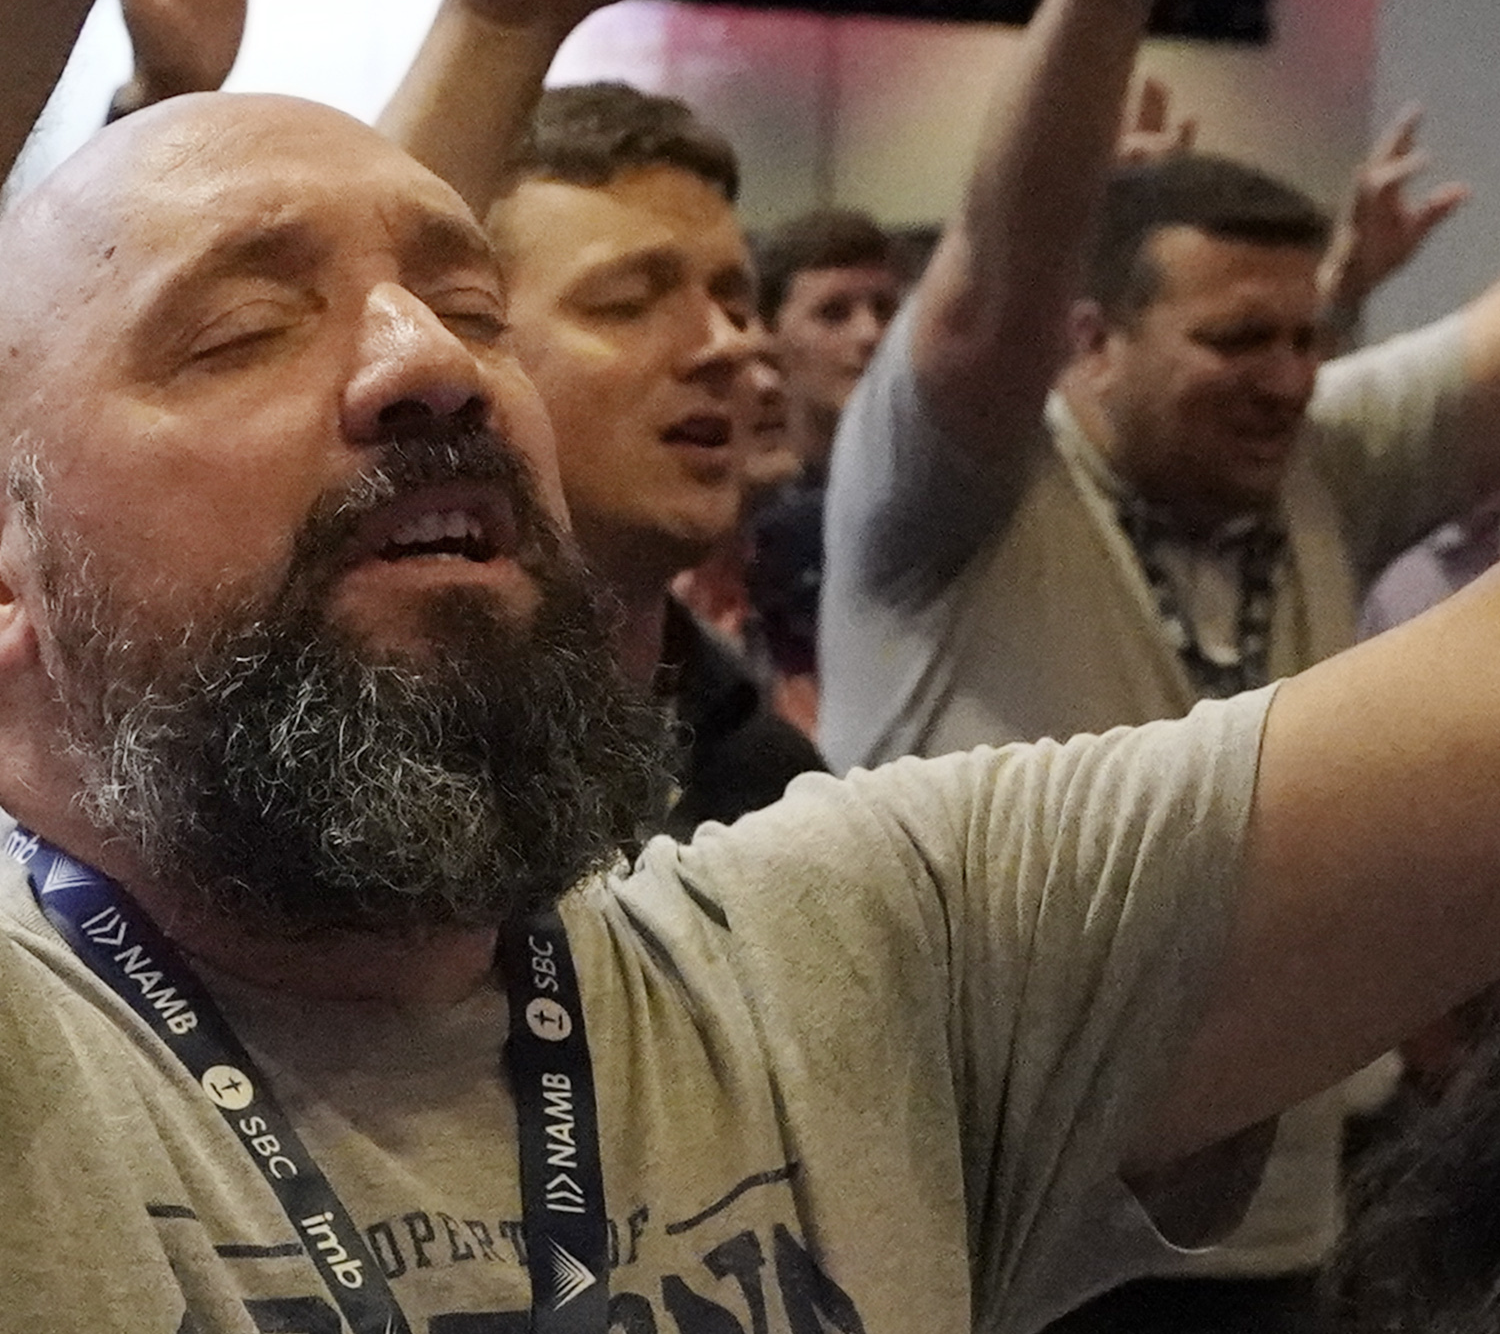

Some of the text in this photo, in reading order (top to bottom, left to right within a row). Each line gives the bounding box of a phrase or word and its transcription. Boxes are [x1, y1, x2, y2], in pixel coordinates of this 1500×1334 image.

[529, 936, 554, 991] SBC
[6, 831, 39, 863] mb
[115, 945, 198, 1036] NAMB
[240, 1116, 297, 1178] SBC
[301, 1211, 364, 1289] imb
[543, 1072, 578, 1168] NAMB
